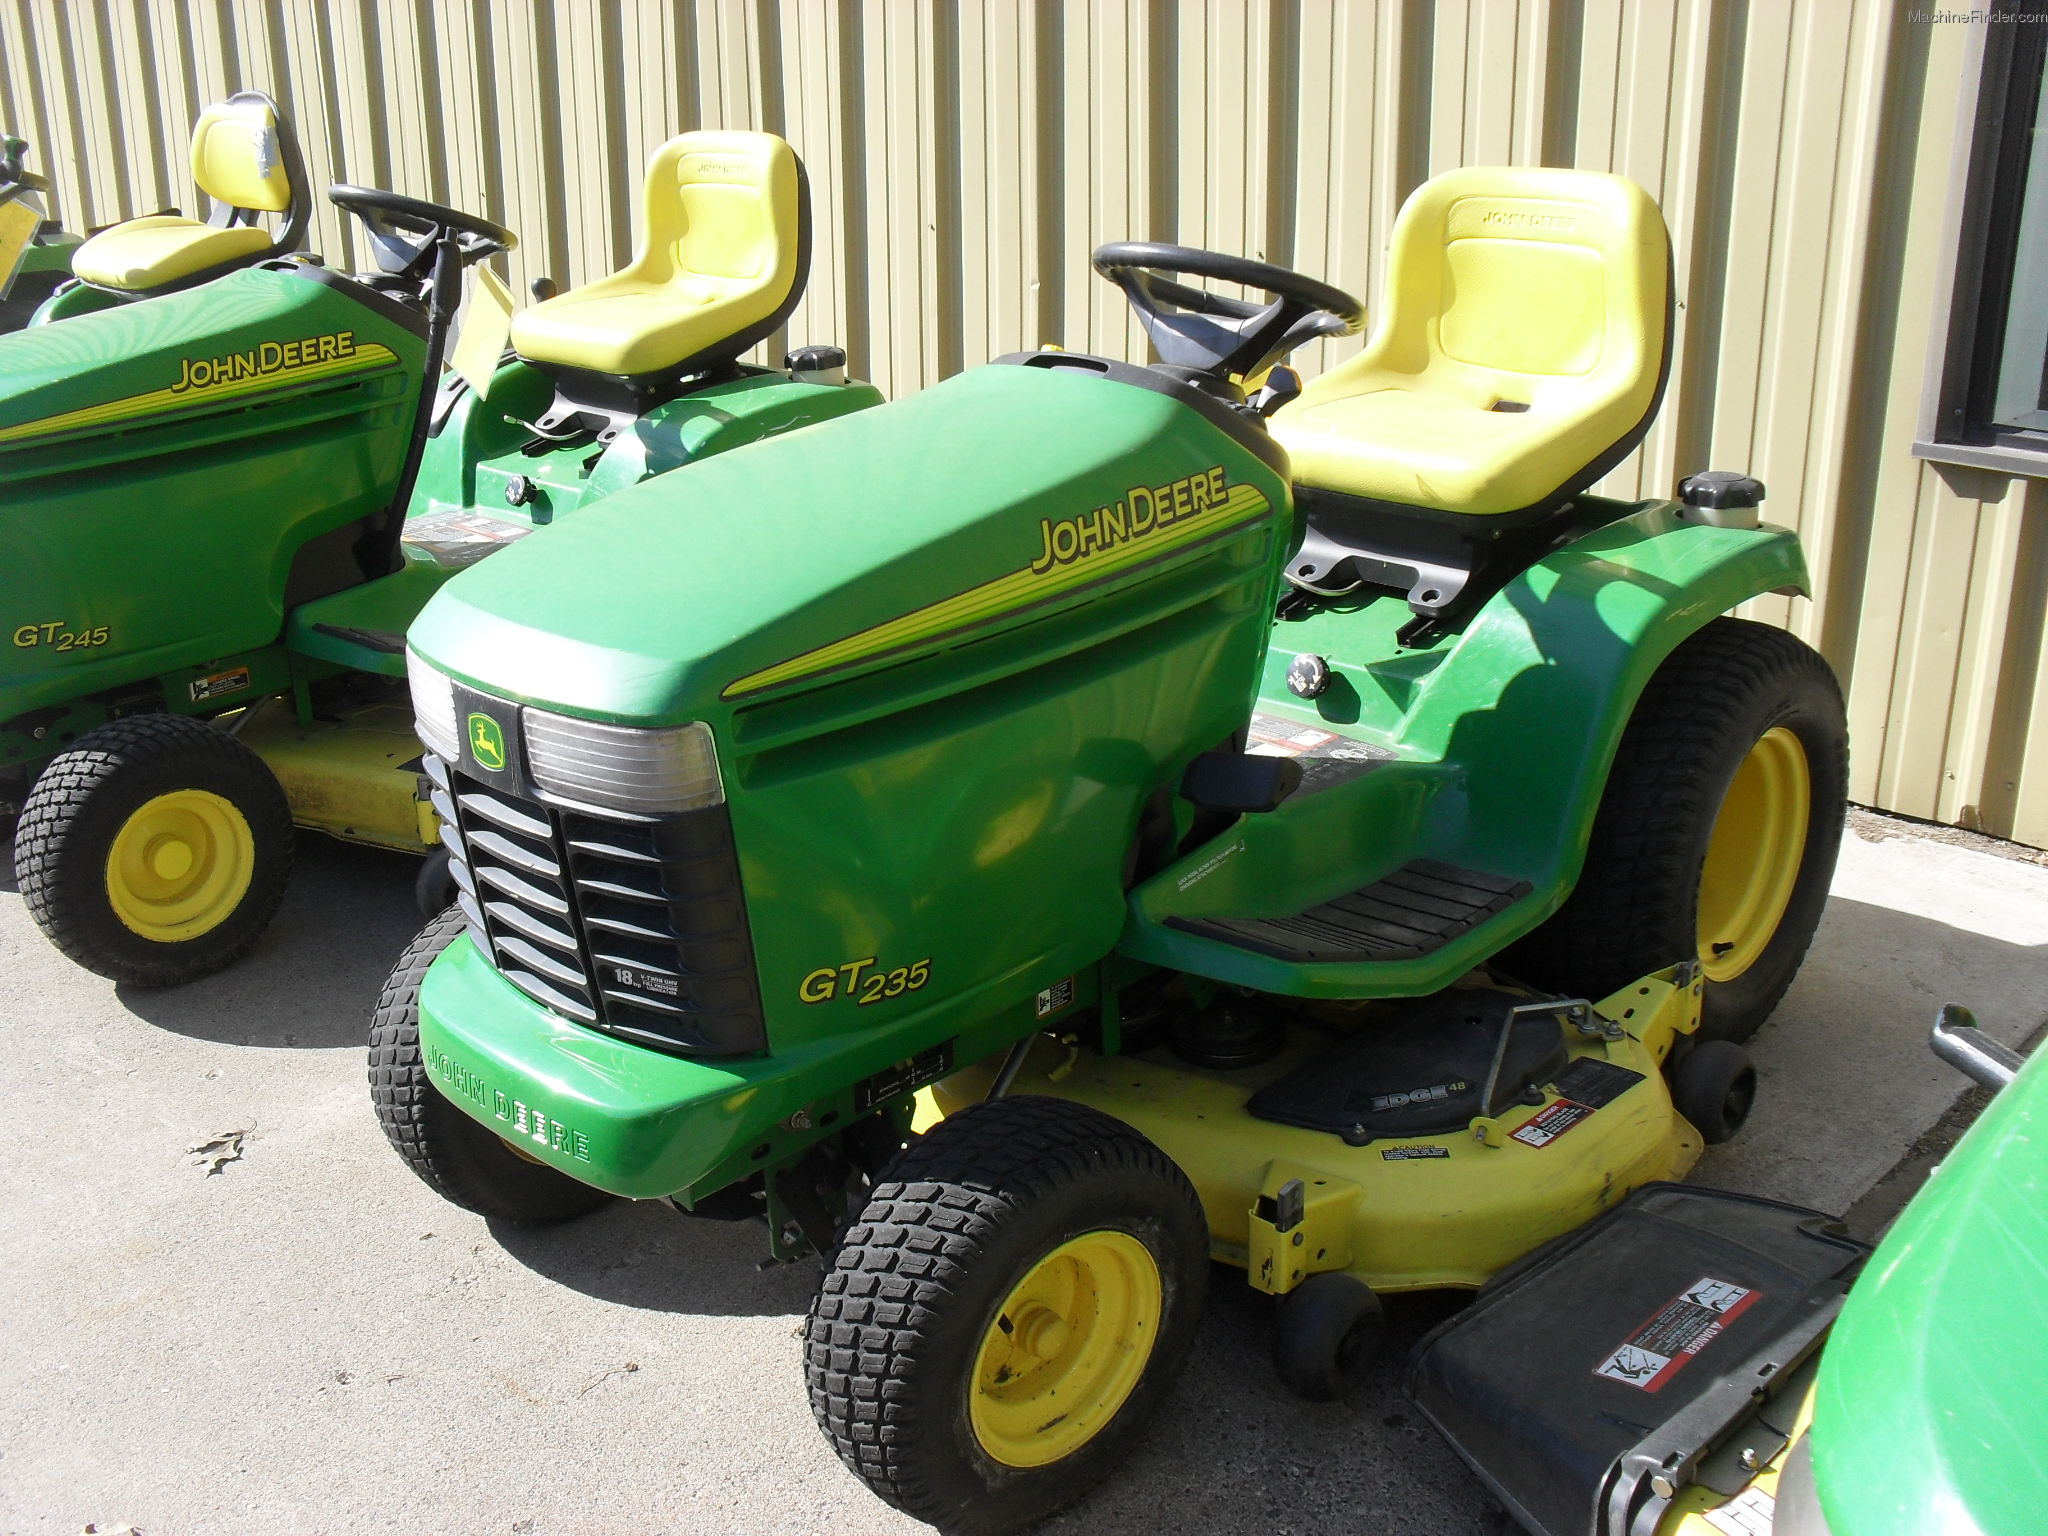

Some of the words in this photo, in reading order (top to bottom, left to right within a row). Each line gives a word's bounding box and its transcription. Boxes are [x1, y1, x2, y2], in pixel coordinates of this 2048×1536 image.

[171, 351, 256, 393] JOHN
[259, 331, 356, 373] DEERE
[1032, 502, 1127, 574] JOHN
[1128, 466, 1228, 537] DEERE
[13, 621, 109, 652] GT245
[800, 957, 931, 1005] GT235
[428, 1045, 486, 1108] JOHN
[493, 1089, 592, 1164] DEERE
[1371, 1084, 1449, 1112] EDGE
[1449, 1081, 1466, 1091] 48
[1682, 1327, 1718, 1355] DANGER
